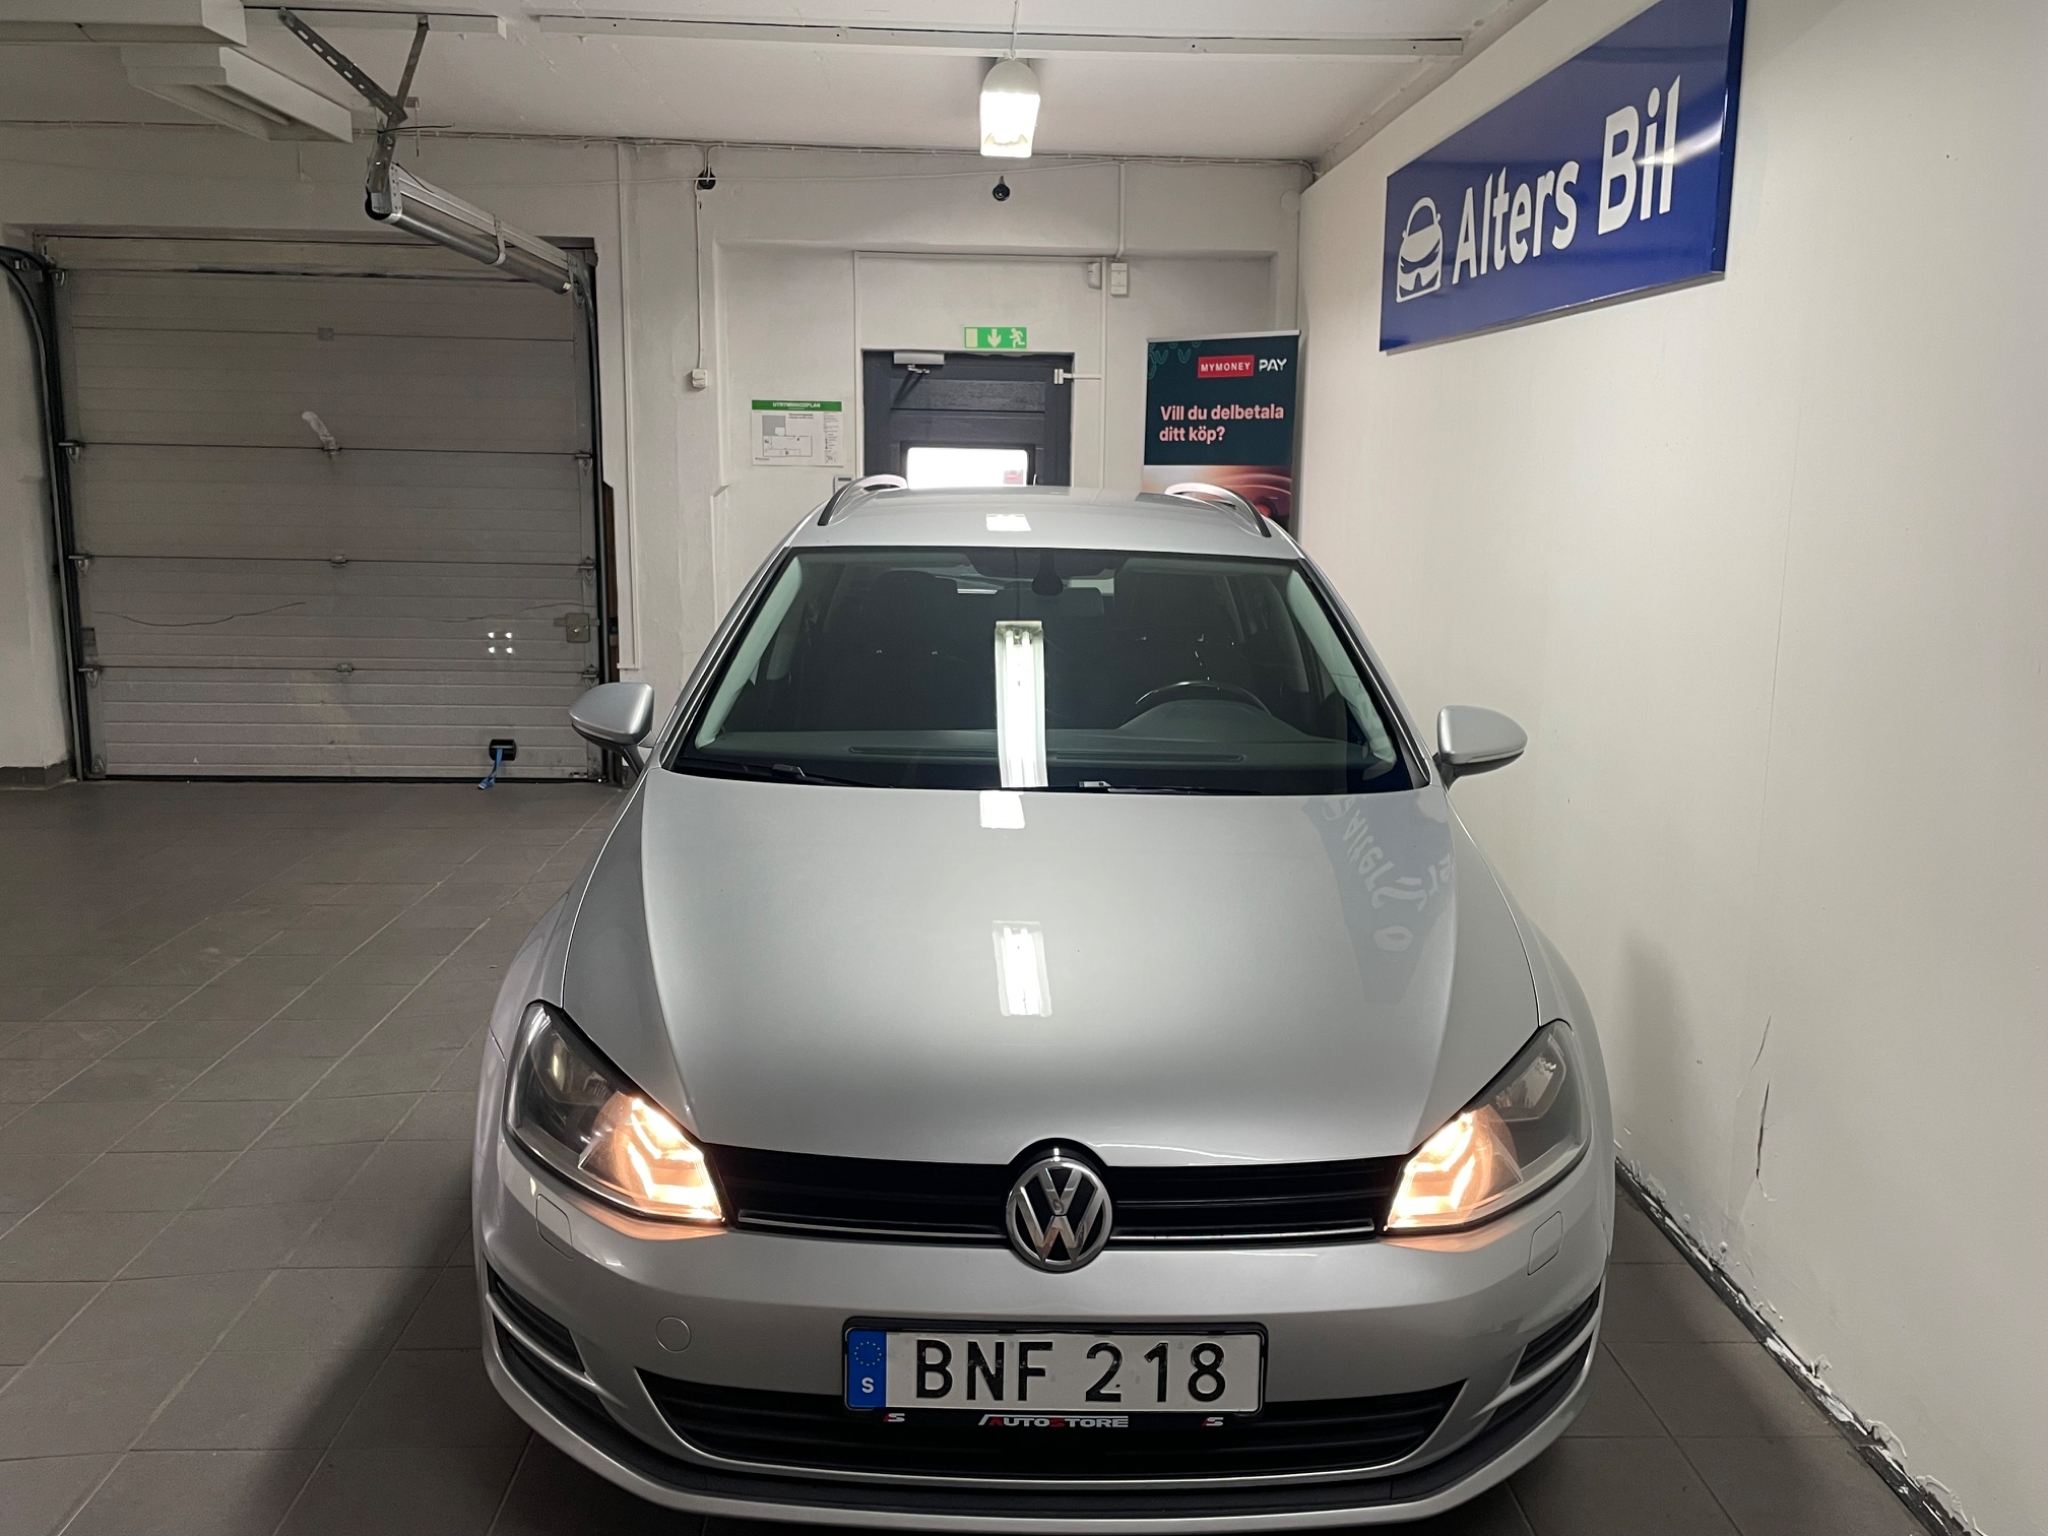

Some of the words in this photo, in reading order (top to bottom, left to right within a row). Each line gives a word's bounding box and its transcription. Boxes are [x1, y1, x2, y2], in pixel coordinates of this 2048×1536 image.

[1452, 160, 1580, 285] Alters
[1598, 74, 1681, 235] Bil
[1200, 362, 1251, 372] MYMONEY
[1259, 358, 1287, 371] PAY
[1160, 406, 1184, 421] Vill
[1188, 406, 1207, 420] du
[1211, 404, 1284, 420] delbetala
[1159, 427, 1185, 442] ditt
[1189, 426, 1226, 444] köp?
[916, 1339, 1054, 1402] BNF
[1085, 1342, 1226, 1403] 218
[861, 1377, 874, 1394] S
[979, 1414, 1129, 1428] AUTOSTORE
